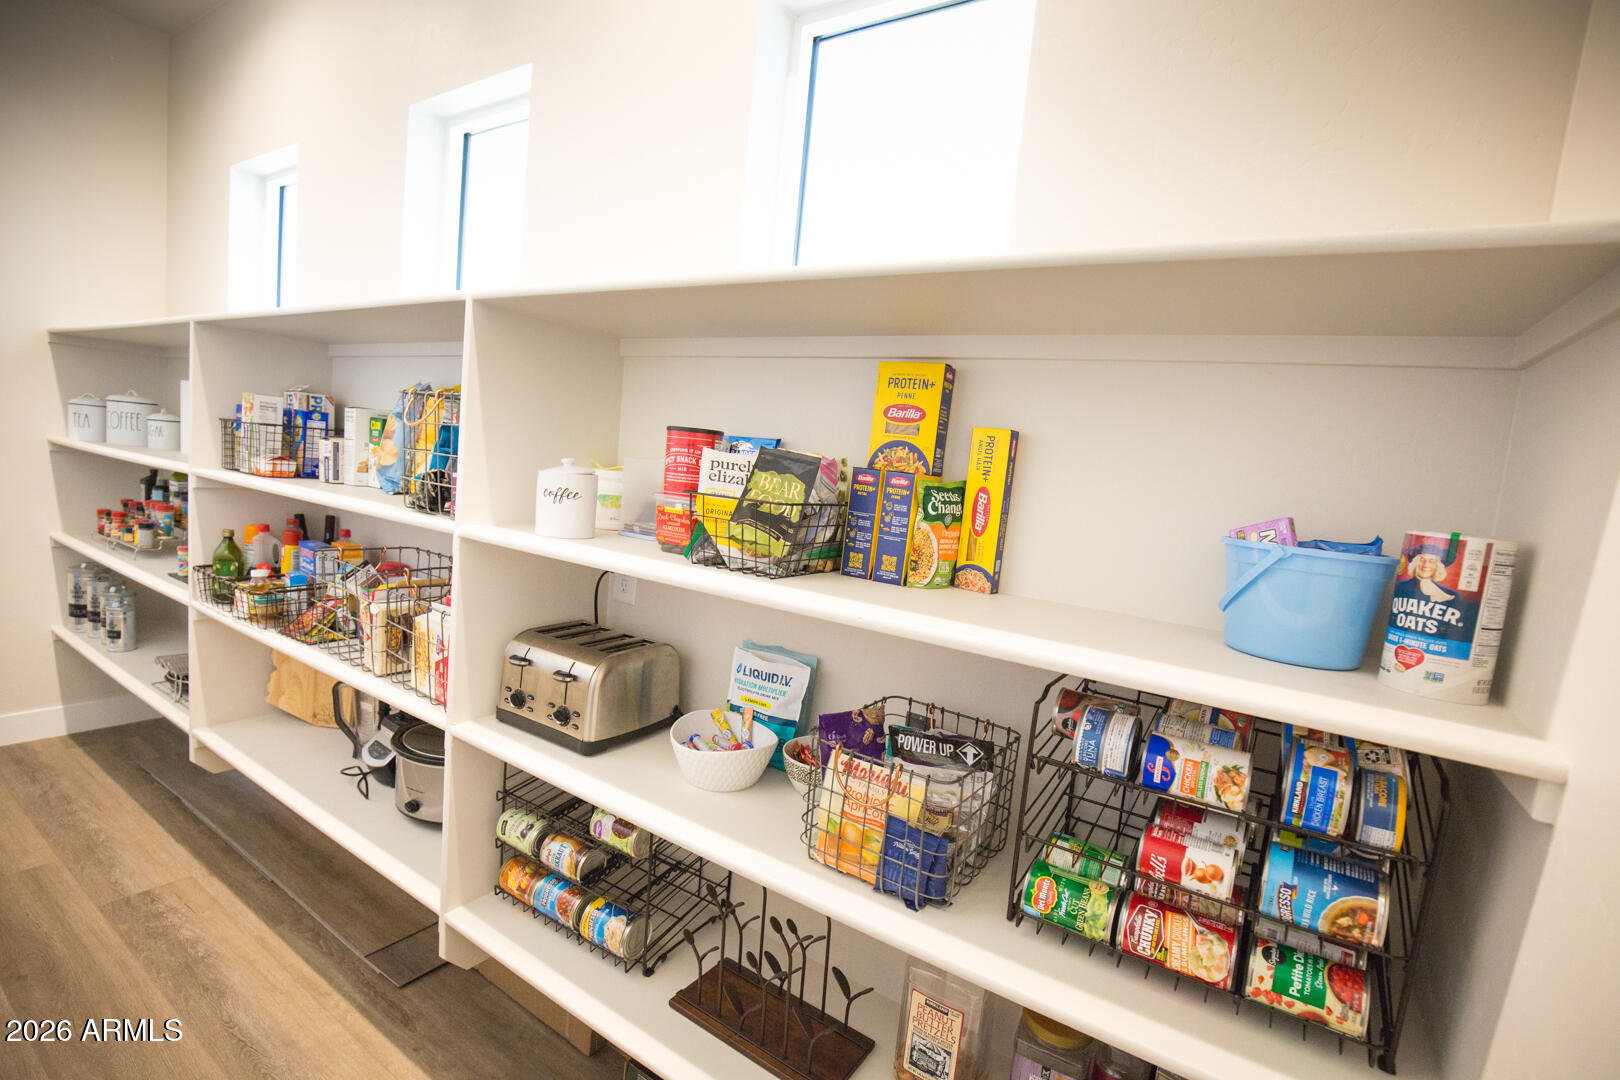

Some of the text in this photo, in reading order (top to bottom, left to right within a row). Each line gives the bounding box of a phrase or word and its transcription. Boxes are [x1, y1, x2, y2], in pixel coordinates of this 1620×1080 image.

[888, 377, 936, 390] PROTEIN+
[72, 412, 91, 429] TEA
[887, 407, 922, 419] Barilla
[676, 456, 697, 465] SNACK
[710, 460, 755, 473] purel
[982, 435, 996, 483] PROTEIN+
[708, 470, 750, 486] eliza
[759, 473, 801, 500] BEAR
[853, 484, 876, 492] PROTEIN+
[543, 487, 582, 505] coffee
[886, 487, 910, 496] PROTEIN+
[705, 508, 733, 517] ORIGINA
[927, 500, 962, 517] Chang
[974, 491, 988, 531] Barilla
[1396, 613, 1439, 634] OATS
[1429, 643, 1447, 653] OATS
[742, 665, 779, 684] LIQUID
[897, 733, 954, 757] POWER UP
[1085, 740, 1097, 762] TUNA
[1182, 761, 1194, 793] CHICKEN
[846, 784, 895, 813] Probiotic
[1291, 781, 1304, 814] KIRKLAND
[1316, 776, 1329, 803] BREAST
[1148, 853, 1168, 882] bell's
[1037, 878, 1051, 912] Del Monte
[1279, 887, 1293, 923] OGRESSO
[1306, 889, 1317, 904] RICE
[1069, 898, 1080, 915] CUT
[1303, 903, 1313, 919] WILD
[1075, 909, 1086, 931] GREEN
[1137, 908, 1159, 956] CHUNKY
[1181, 917, 1189, 966] DUMPLINGS
[1289, 962, 1305, 997] Petite
[1304, 965, 1312, 996] TOMATOES
[916, 1010, 954, 1035] BUTTER
[917, 1002, 956, 1027] PEANUT
[912, 1015, 956, 1045] PRETZELS
